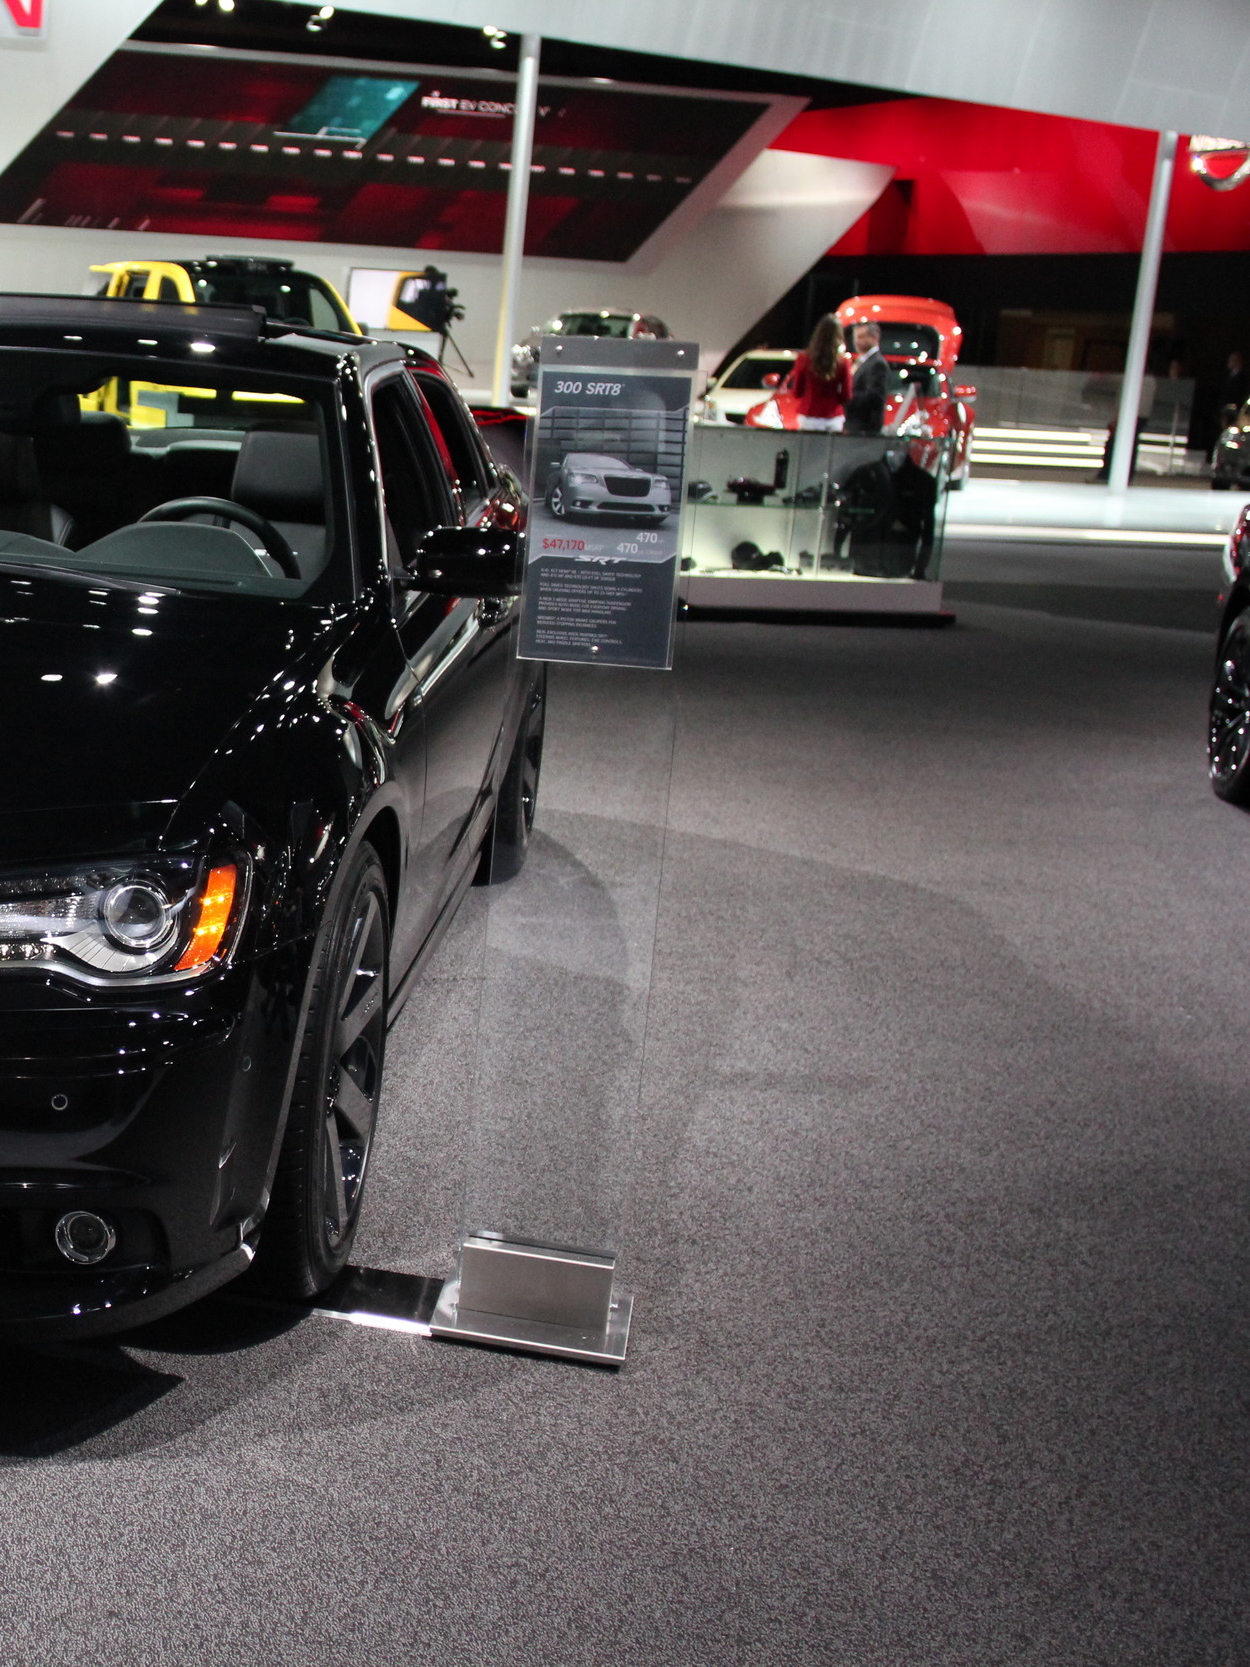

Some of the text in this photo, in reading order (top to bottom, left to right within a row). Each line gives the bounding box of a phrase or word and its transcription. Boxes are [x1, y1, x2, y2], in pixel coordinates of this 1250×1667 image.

[421, 96, 458, 110] FIRST
[554, 380, 622, 396] 300 SRT8
[636, 532, 658, 543] 470
[542, 538, 585, 551] $47,170
[616, 543, 638, 553] 470
